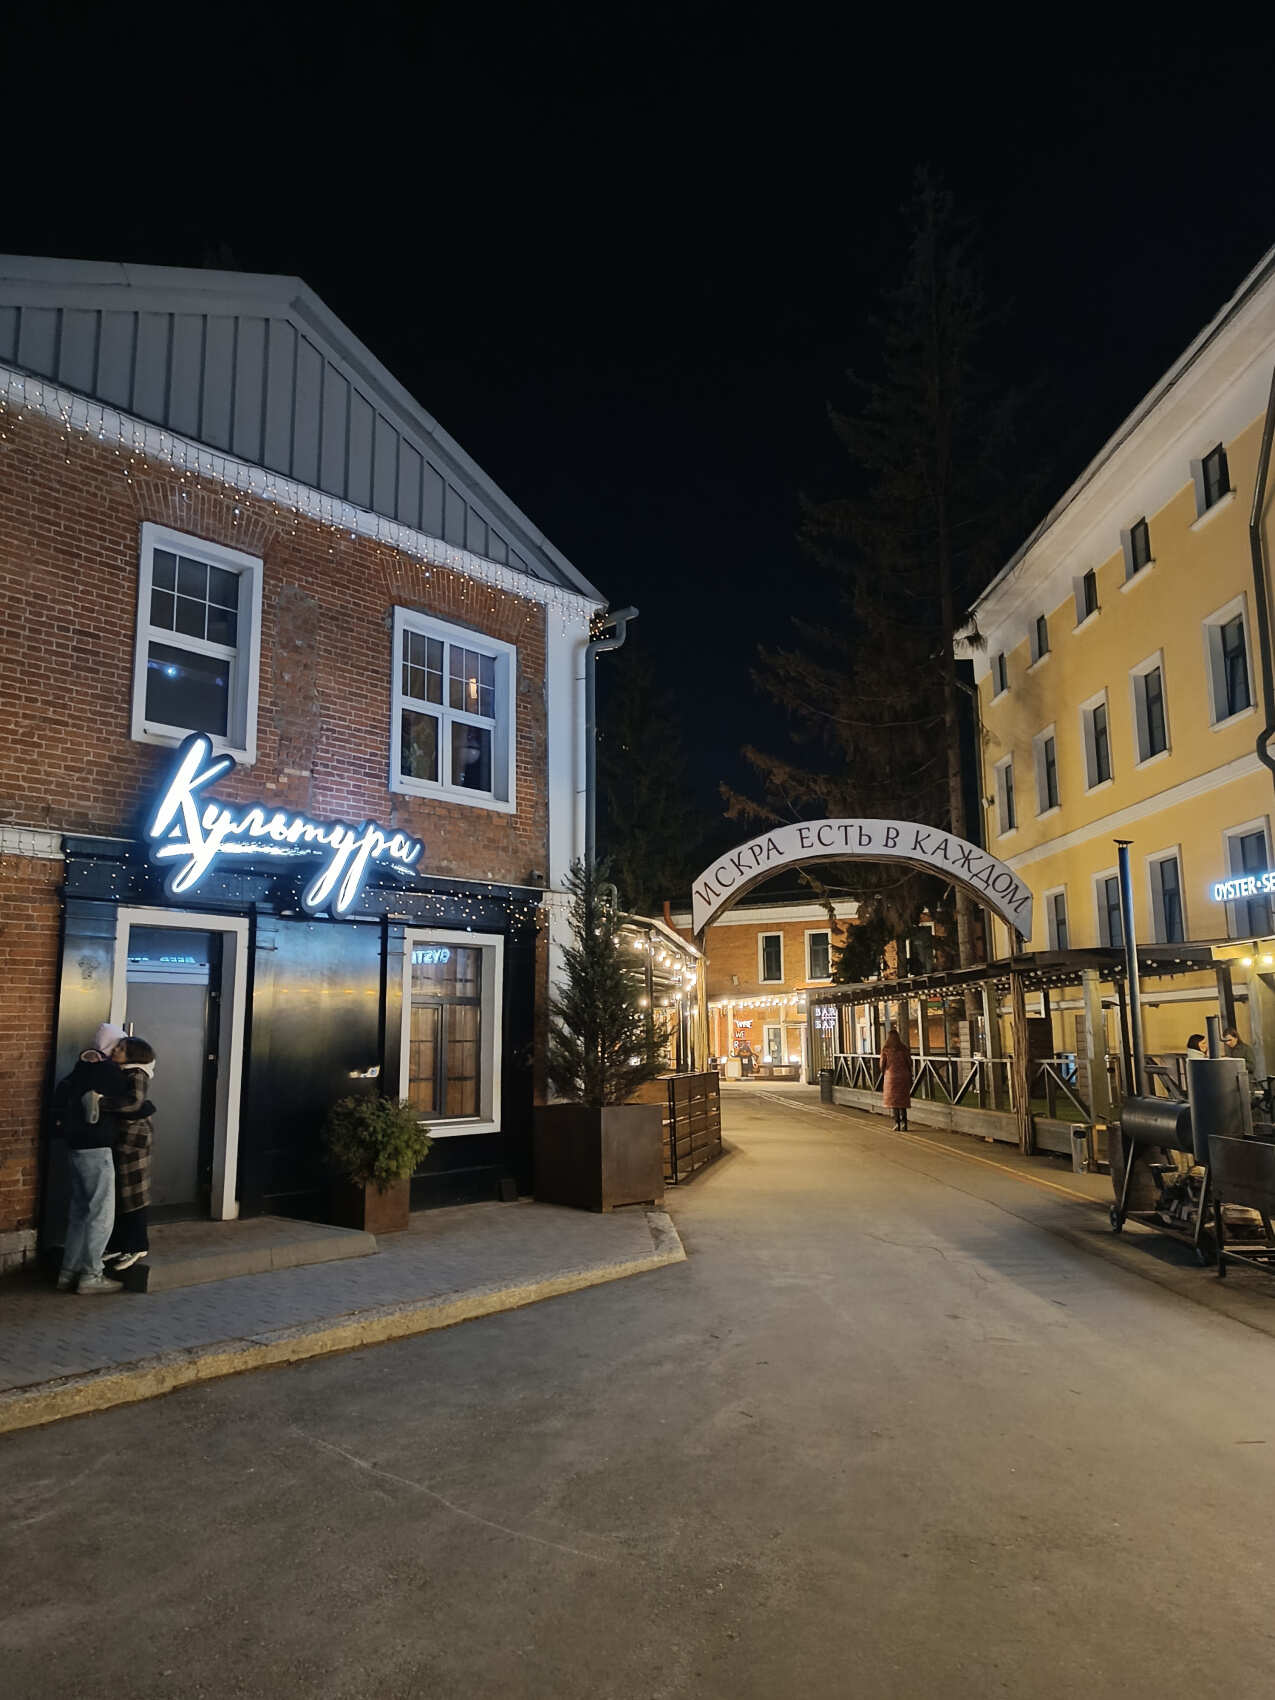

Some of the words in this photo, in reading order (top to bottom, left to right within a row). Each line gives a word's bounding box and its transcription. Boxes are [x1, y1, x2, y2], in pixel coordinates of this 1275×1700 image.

[149, 737, 422, 913] Культура
[694, 836, 785, 906] ИСКРА
[797, 823, 873, 849] ЕСТЬ
[883, 826, 900, 849] В
[911, 829, 1031, 914] КАЖДОМ
[1214, 877, 1258, 901] OYSTER
